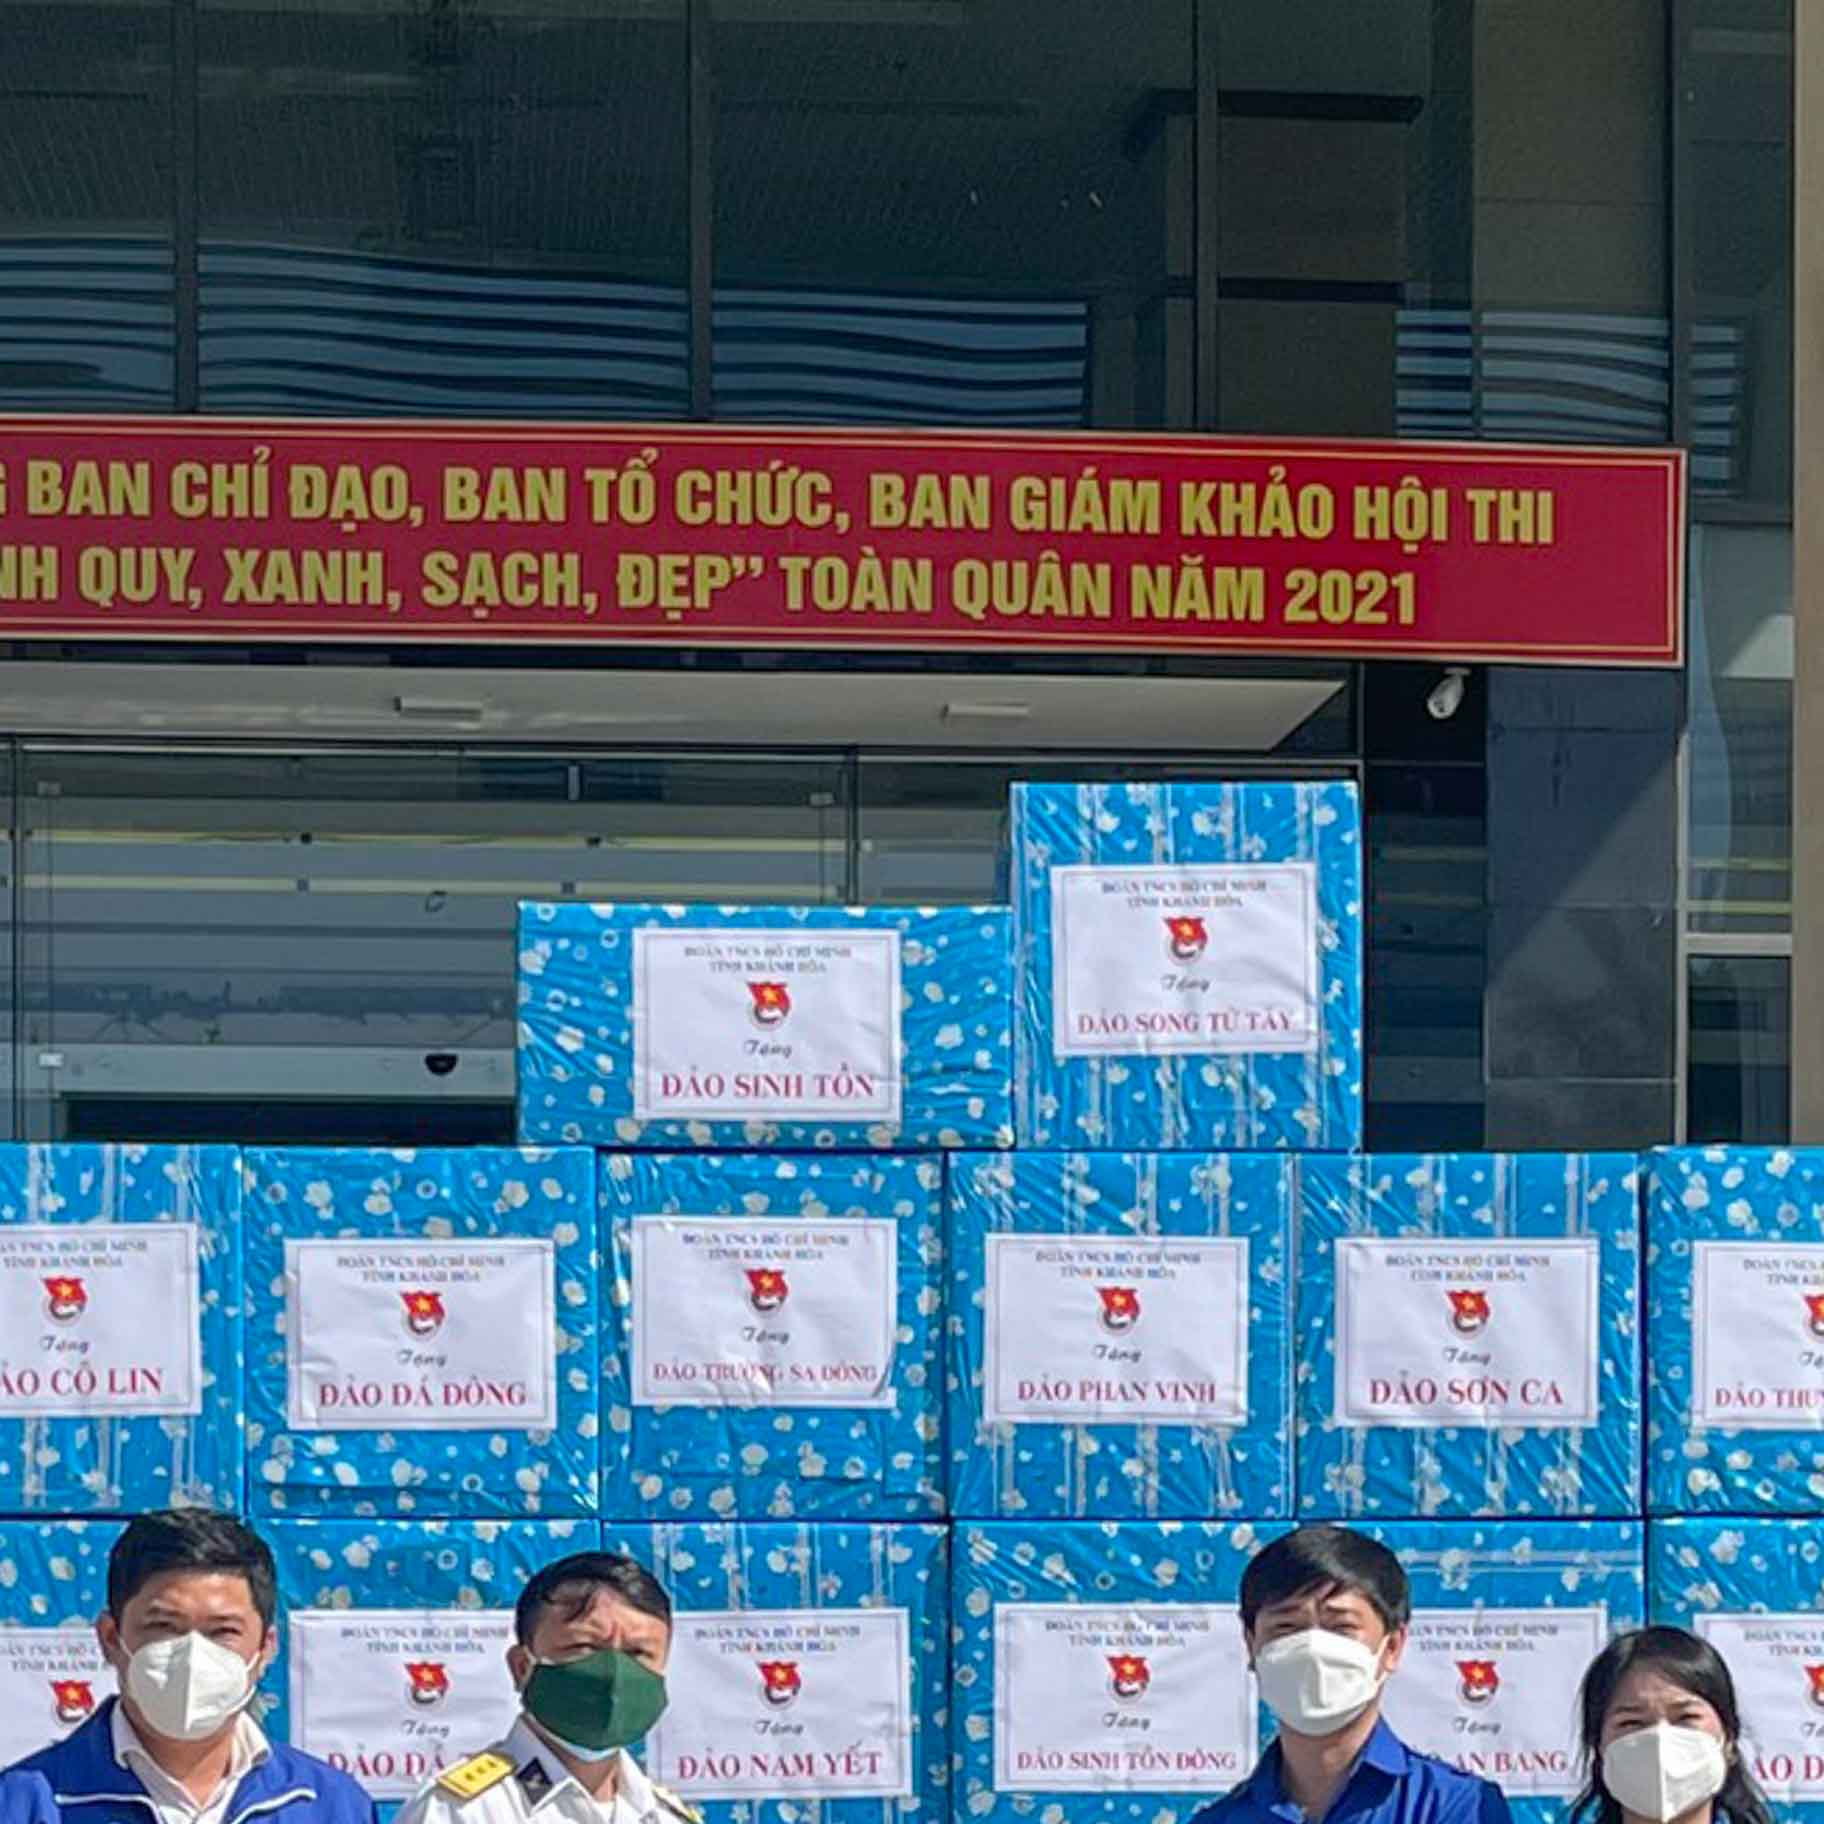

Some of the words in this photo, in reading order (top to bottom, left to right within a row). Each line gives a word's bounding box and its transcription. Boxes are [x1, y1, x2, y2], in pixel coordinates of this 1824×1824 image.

[27, 461, 150, 517] BAN
[170, 447, 268, 520] CHỈ
[289, 464, 424, 534] ĐẠO,
[443, 466, 566, 522] BAN
[584, 447, 660, 524] TỔ
[677, 461, 848, 540] CHỨC,
[870, 473, 990, 532] BAN
[1010, 467, 1160, 535] GIÁM
[1180, 465, 1335, 539] KHẢO
[1352, 475, 1448, 557] HỘI
[1467, 487, 1554, 545] THI
[79, 548, 202, 614] QUY,
[223, 551, 400, 614] XANH,
[421, 553, 599, 622] SẠCH,
[780, 545, 934, 616] TOÀN
[952, 559, 1112, 620] QUÂN
[1130, 561, 1265, 622] NĂM
[1284, 570, 1417, 625] 2021
